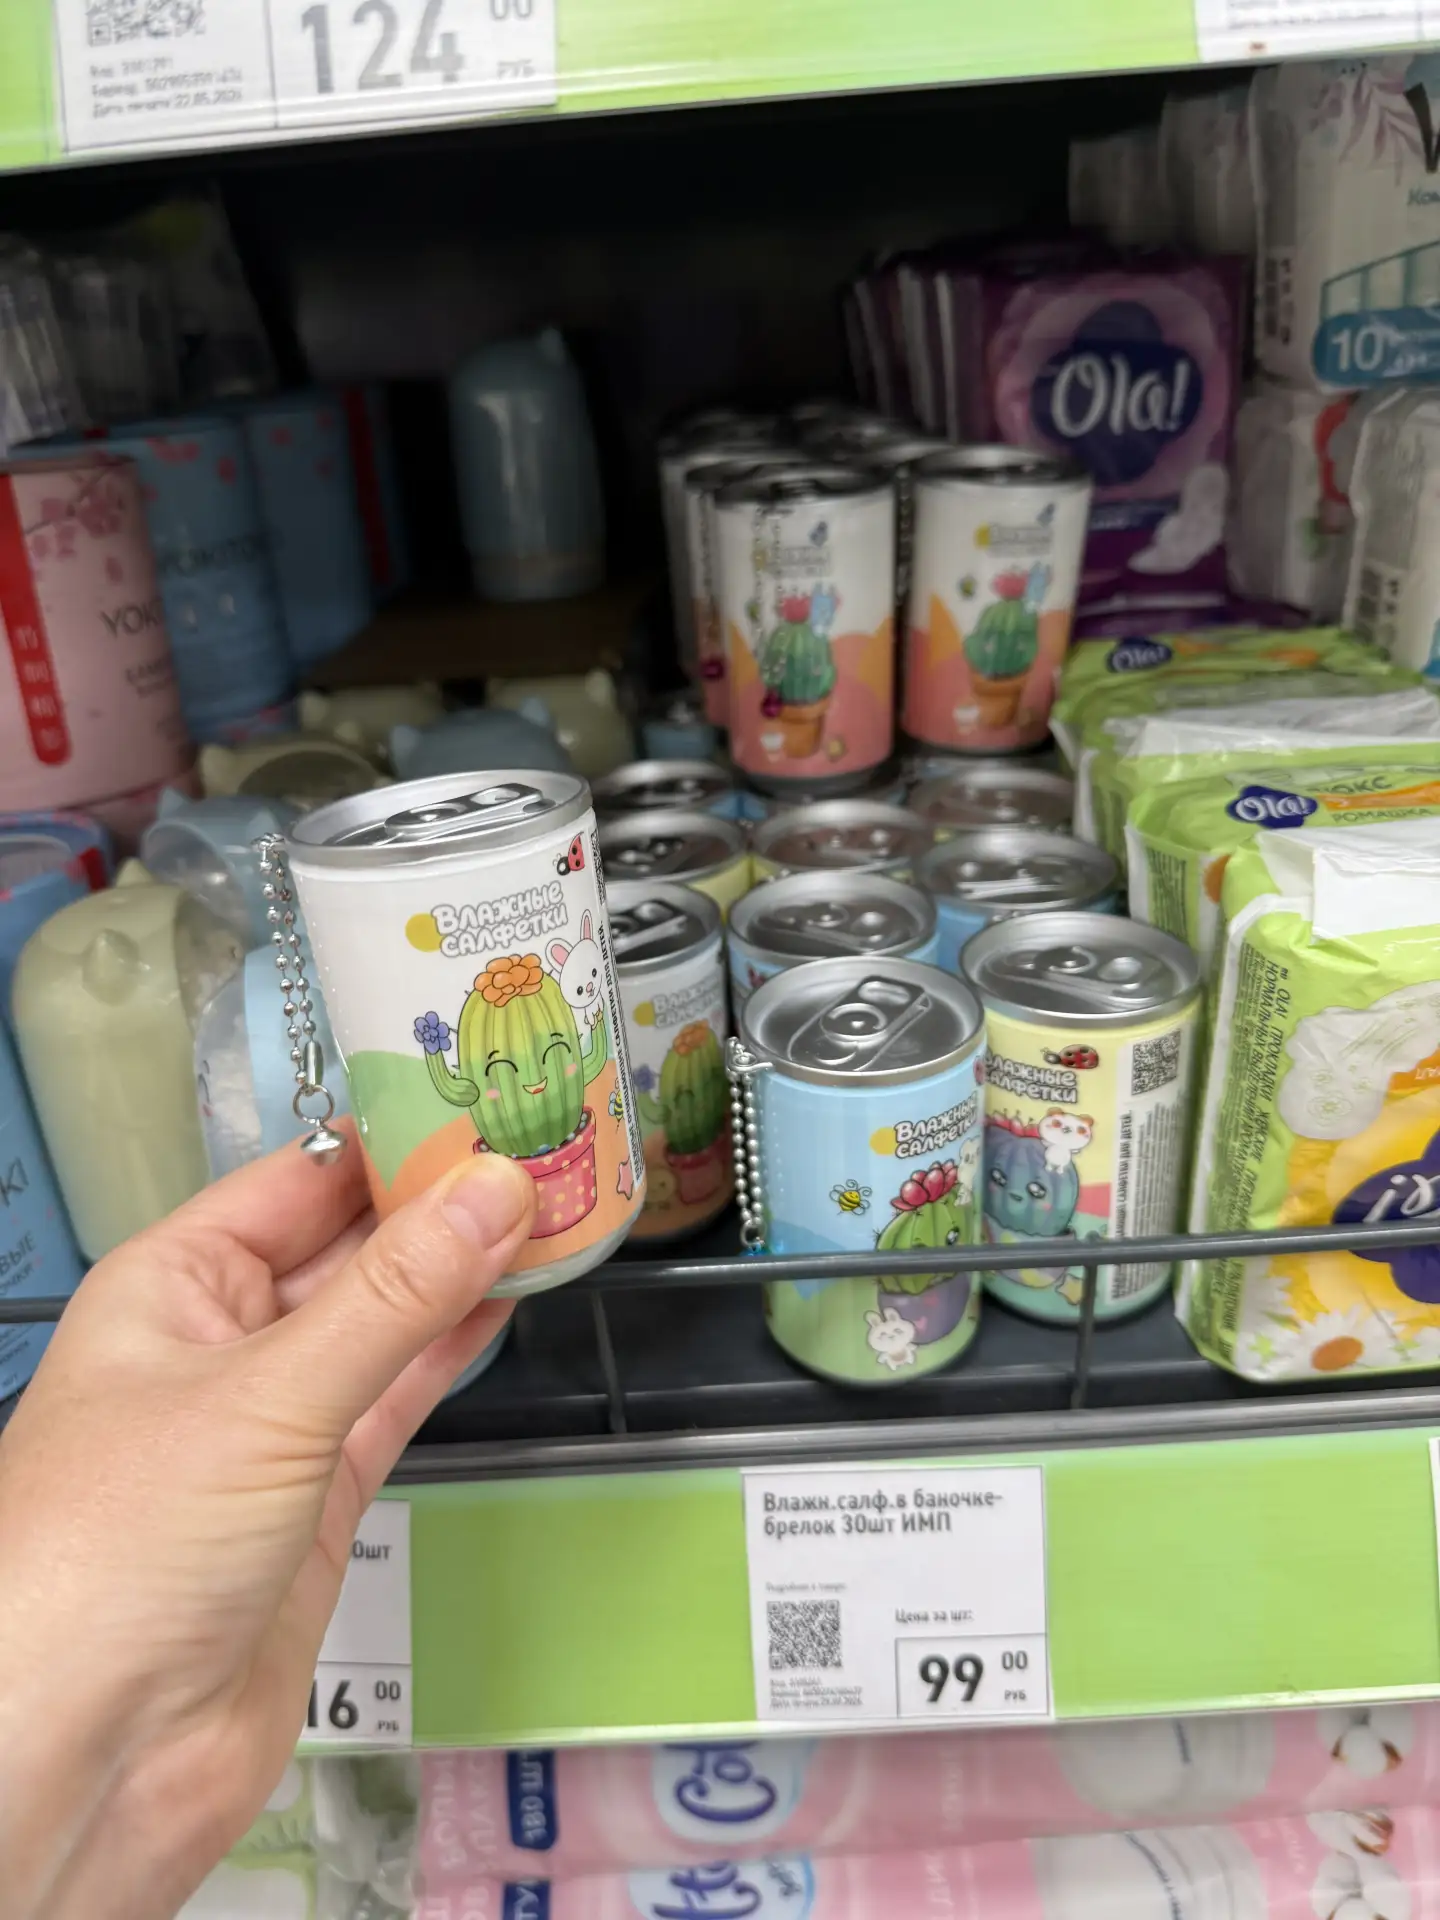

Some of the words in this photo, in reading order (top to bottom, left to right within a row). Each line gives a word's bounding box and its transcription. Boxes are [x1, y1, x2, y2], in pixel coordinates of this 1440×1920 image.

[301, 0, 465, 94] 124
[1051, 352, 1191, 438] Ola!
[1236, 794, 1309, 821] Ola!
[603, 961, 614, 985] ДЛЯ
[1254, 959, 1279, 1047] НОРМАЛЬНЫХ
[1275, 988, 1291, 1019] OLA!
[1259, 1026, 1284, 1102] ПРОКЛАДКИ
[763, 1490, 907, 1512] Влажн.салф.в
[913, 1488, 1004, 1509] баночке-
[764, 1515, 836, 1539] брелок
[843, 1514, 895, 1534] 30шт
[902, 1511, 952, 1531] ИМП
[895, 1608, 929, 1623] Цена
[933, 1611, 947, 1621] за
[1001, 1650, 1028, 1670] 00
[375, 1680, 401, 1700] 00
[919, 1653, 984, 1703] 99
[1004, 1689, 1027, 1701] РУБ
